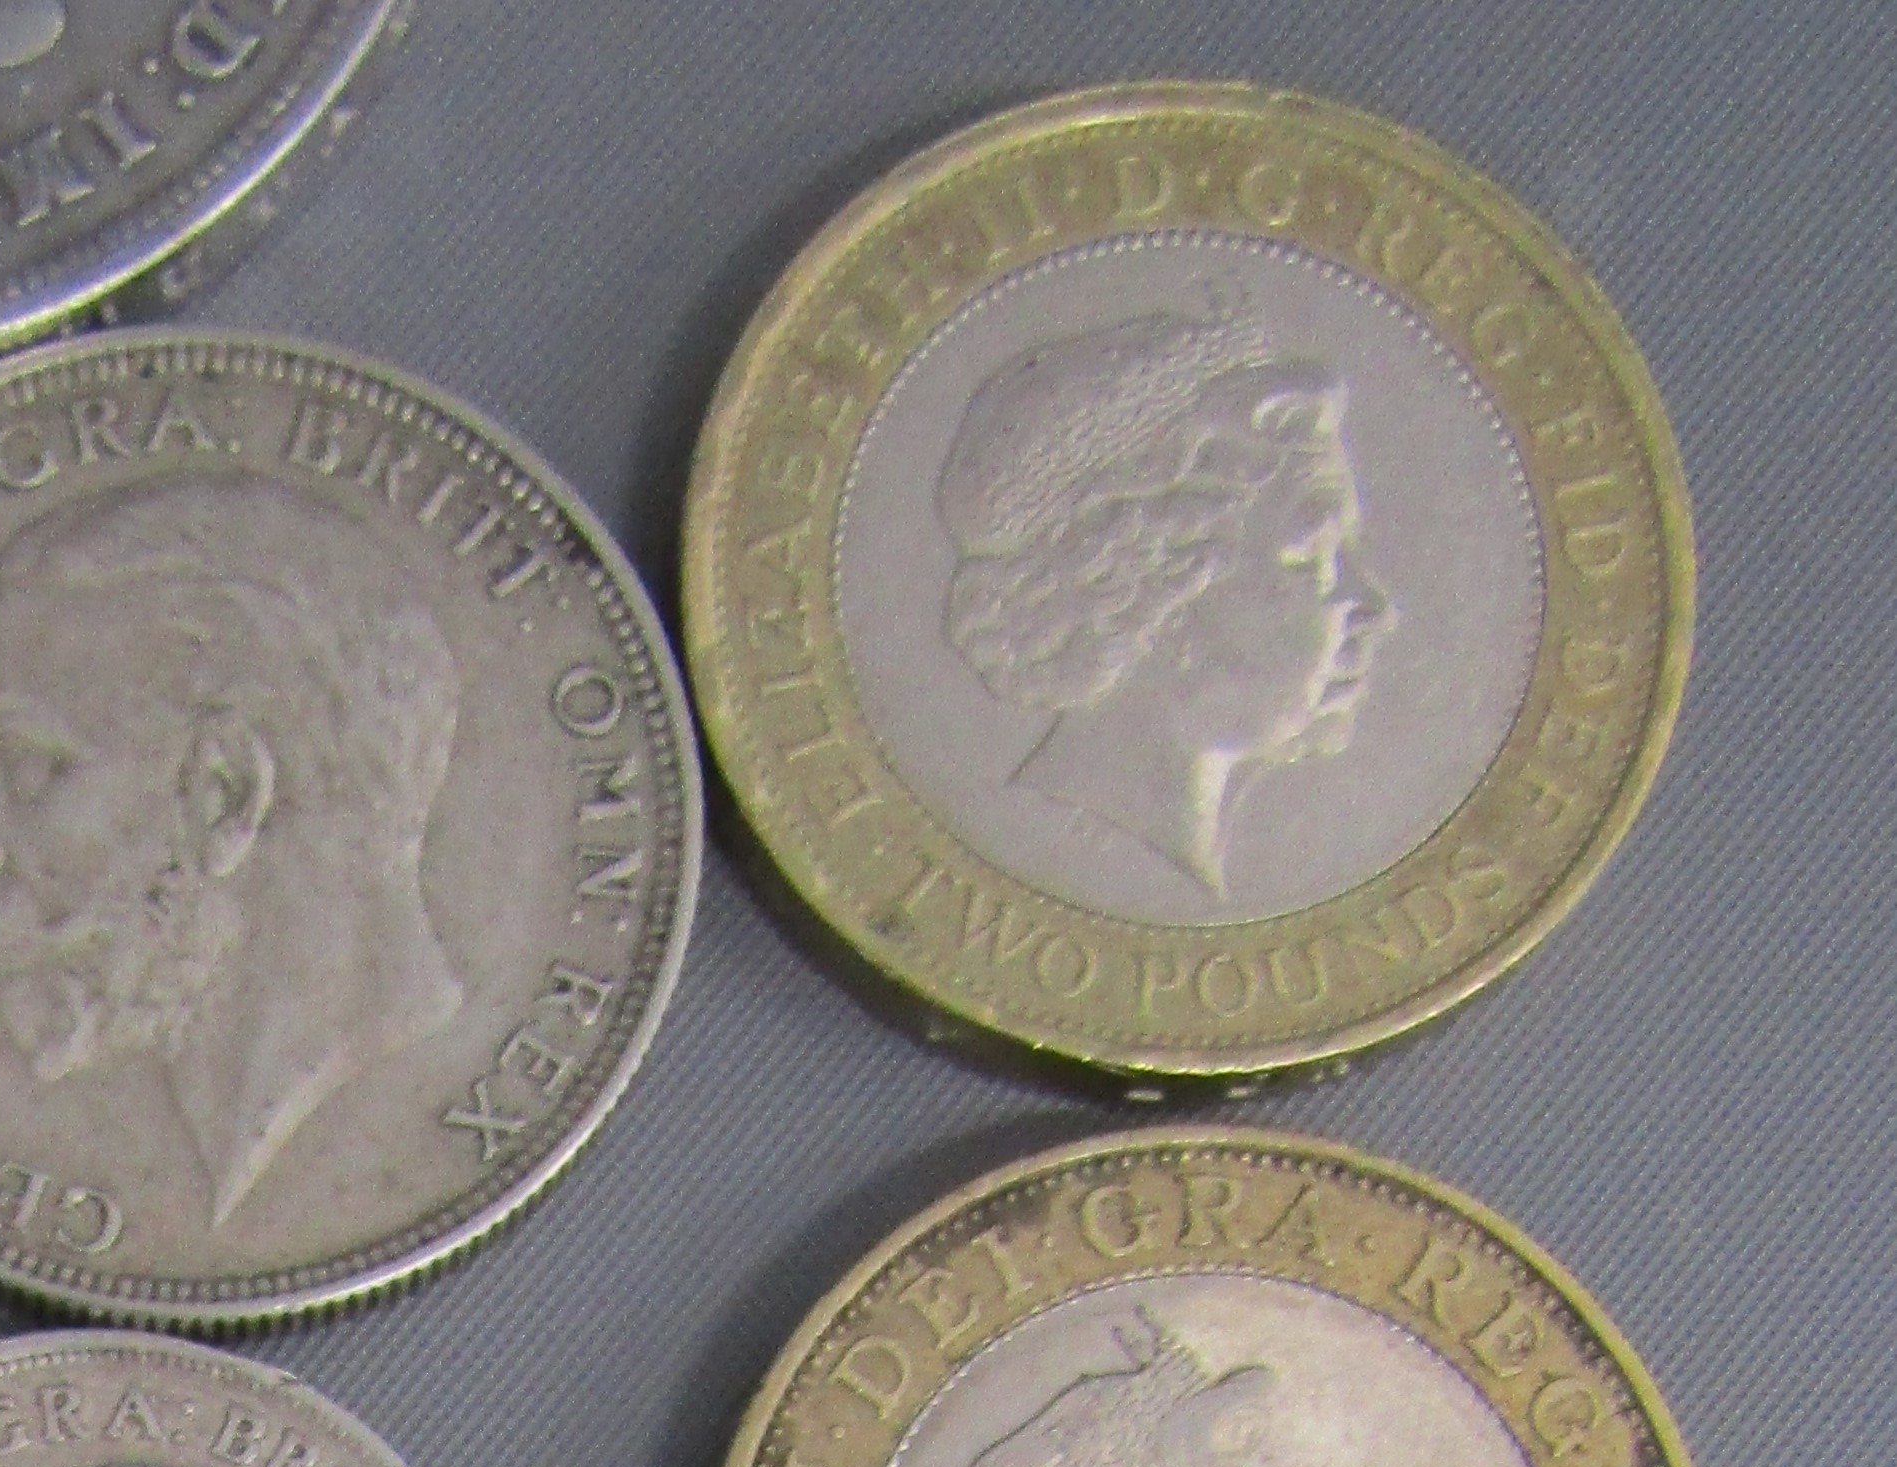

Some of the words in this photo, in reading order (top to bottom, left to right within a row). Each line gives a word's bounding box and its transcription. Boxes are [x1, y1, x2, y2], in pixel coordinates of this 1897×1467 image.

[1115, 155, 1175, 216] D
[1235, 163, 1301, 226] G
[1355, 200, 1538, 370] REG
[1533, 405, 1625, 578] FID
[1515, 638, 1625, 825] DEF
[903, 860, 1098, 1000] TWO
[1133, 850, 1506, 1020] POUNDS
[442, 958, 618, 1162] REX
[833, 1238, 1037, 1421] DEI
[1077, 1172, 1336, 1266] GRA
[1399, 1238, 1611, 1460] REG
